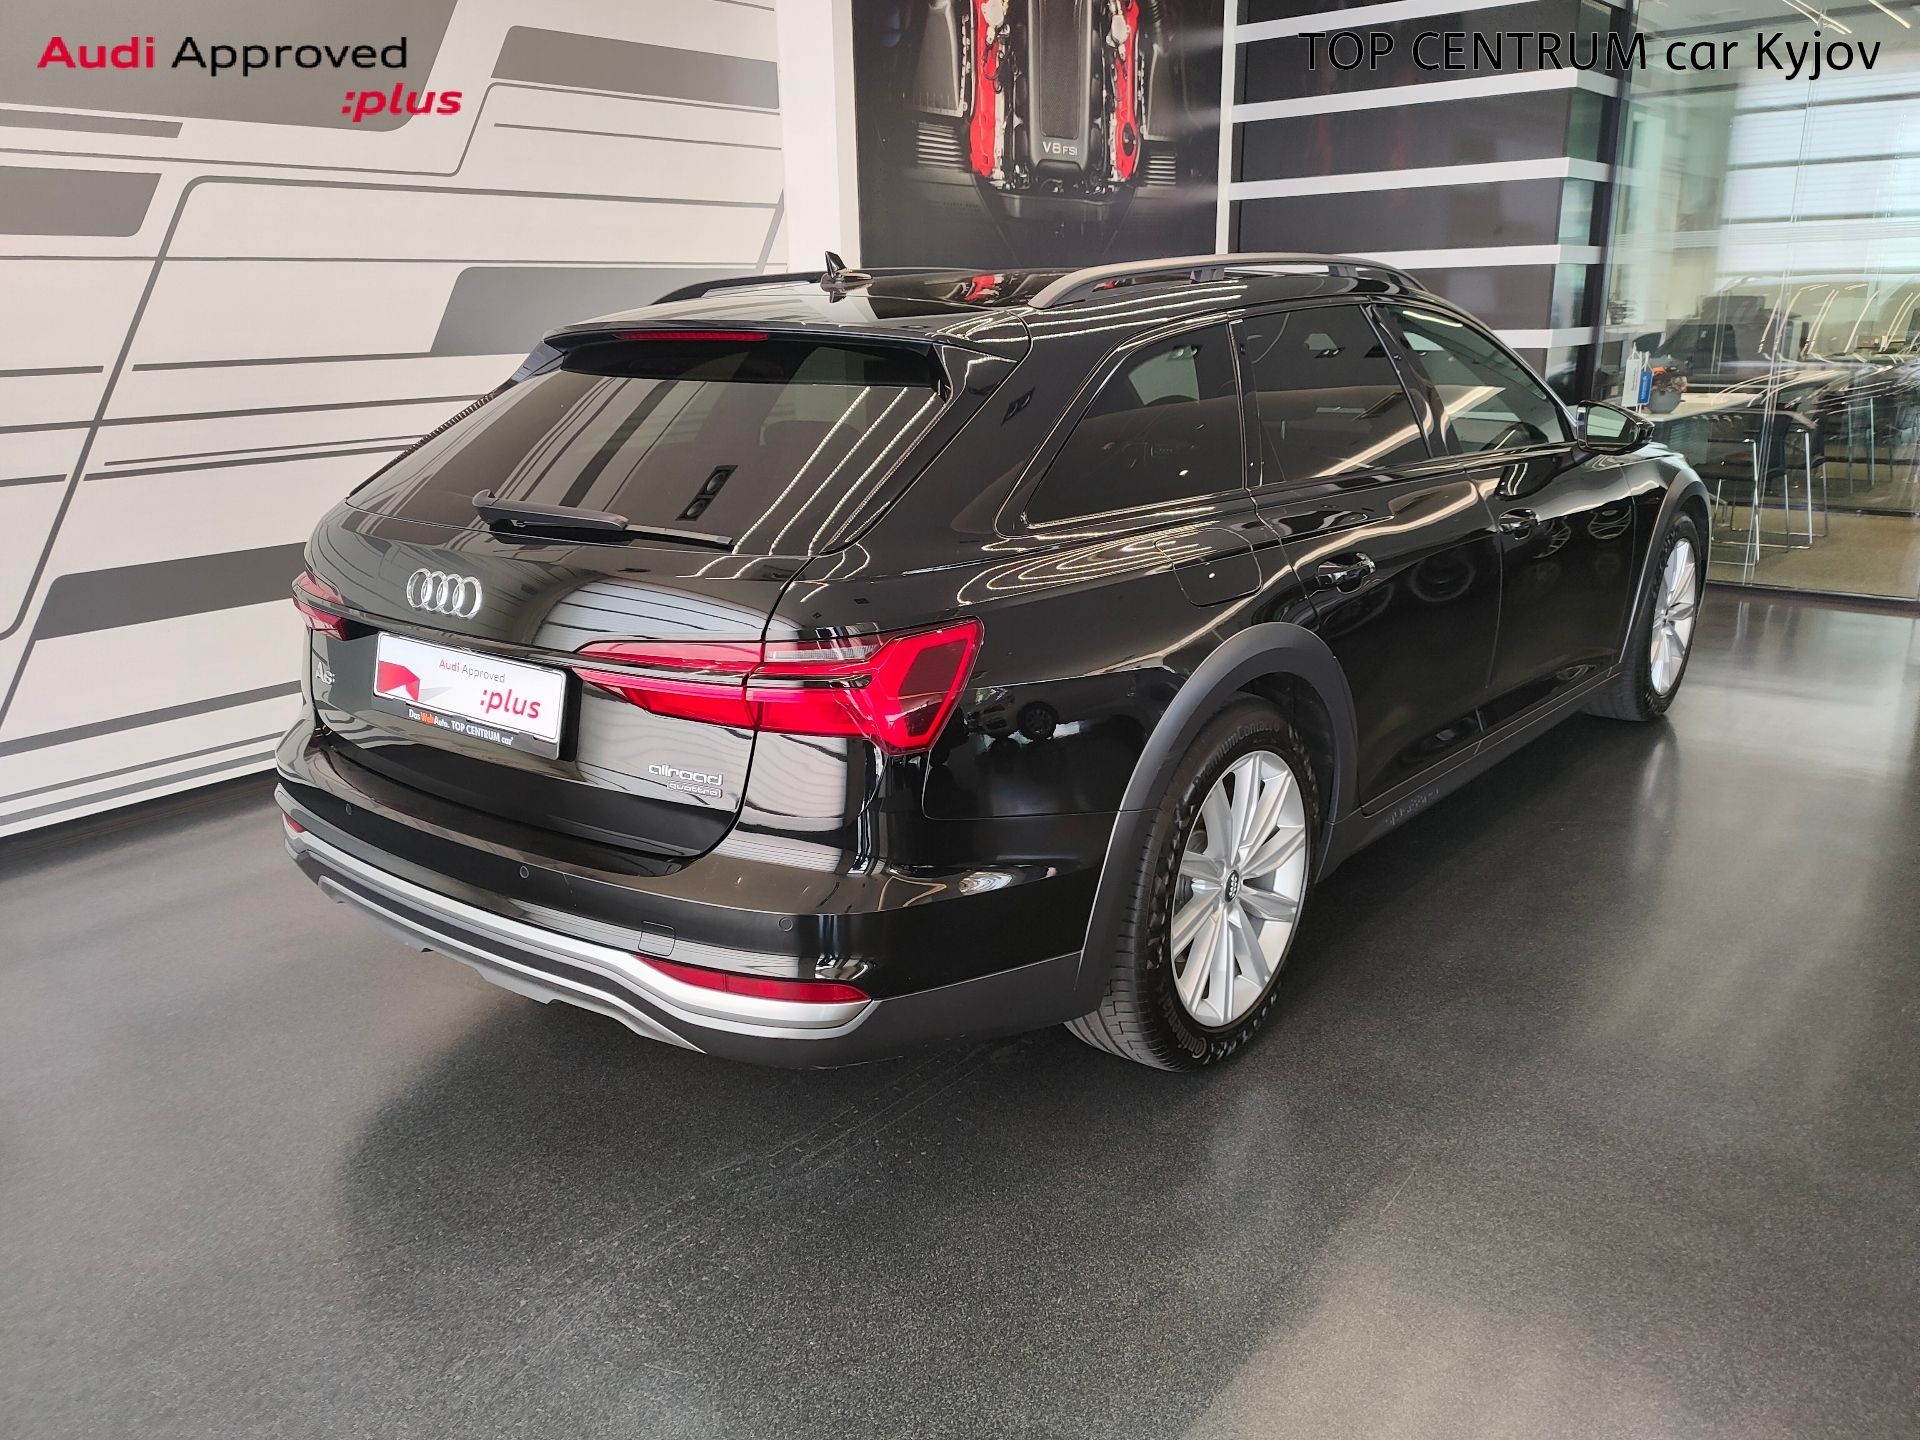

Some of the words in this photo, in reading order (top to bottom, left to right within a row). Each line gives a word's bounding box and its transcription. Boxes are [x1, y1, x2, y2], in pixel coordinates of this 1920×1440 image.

[1042, 141, 1061, 154] V8
[1062, 145, 1078, 156] FSI
[439, 659, 460, 673] Audi
[461, 664, 506, 684] Approved
[479, 688, 541, 719] :plus
[451, 720, 466, 732] TOP
[466, 724, 500, 743] CENTRUM
[648, 764, 723, 786] allroad
[669, 782, 718, 797] quattro
